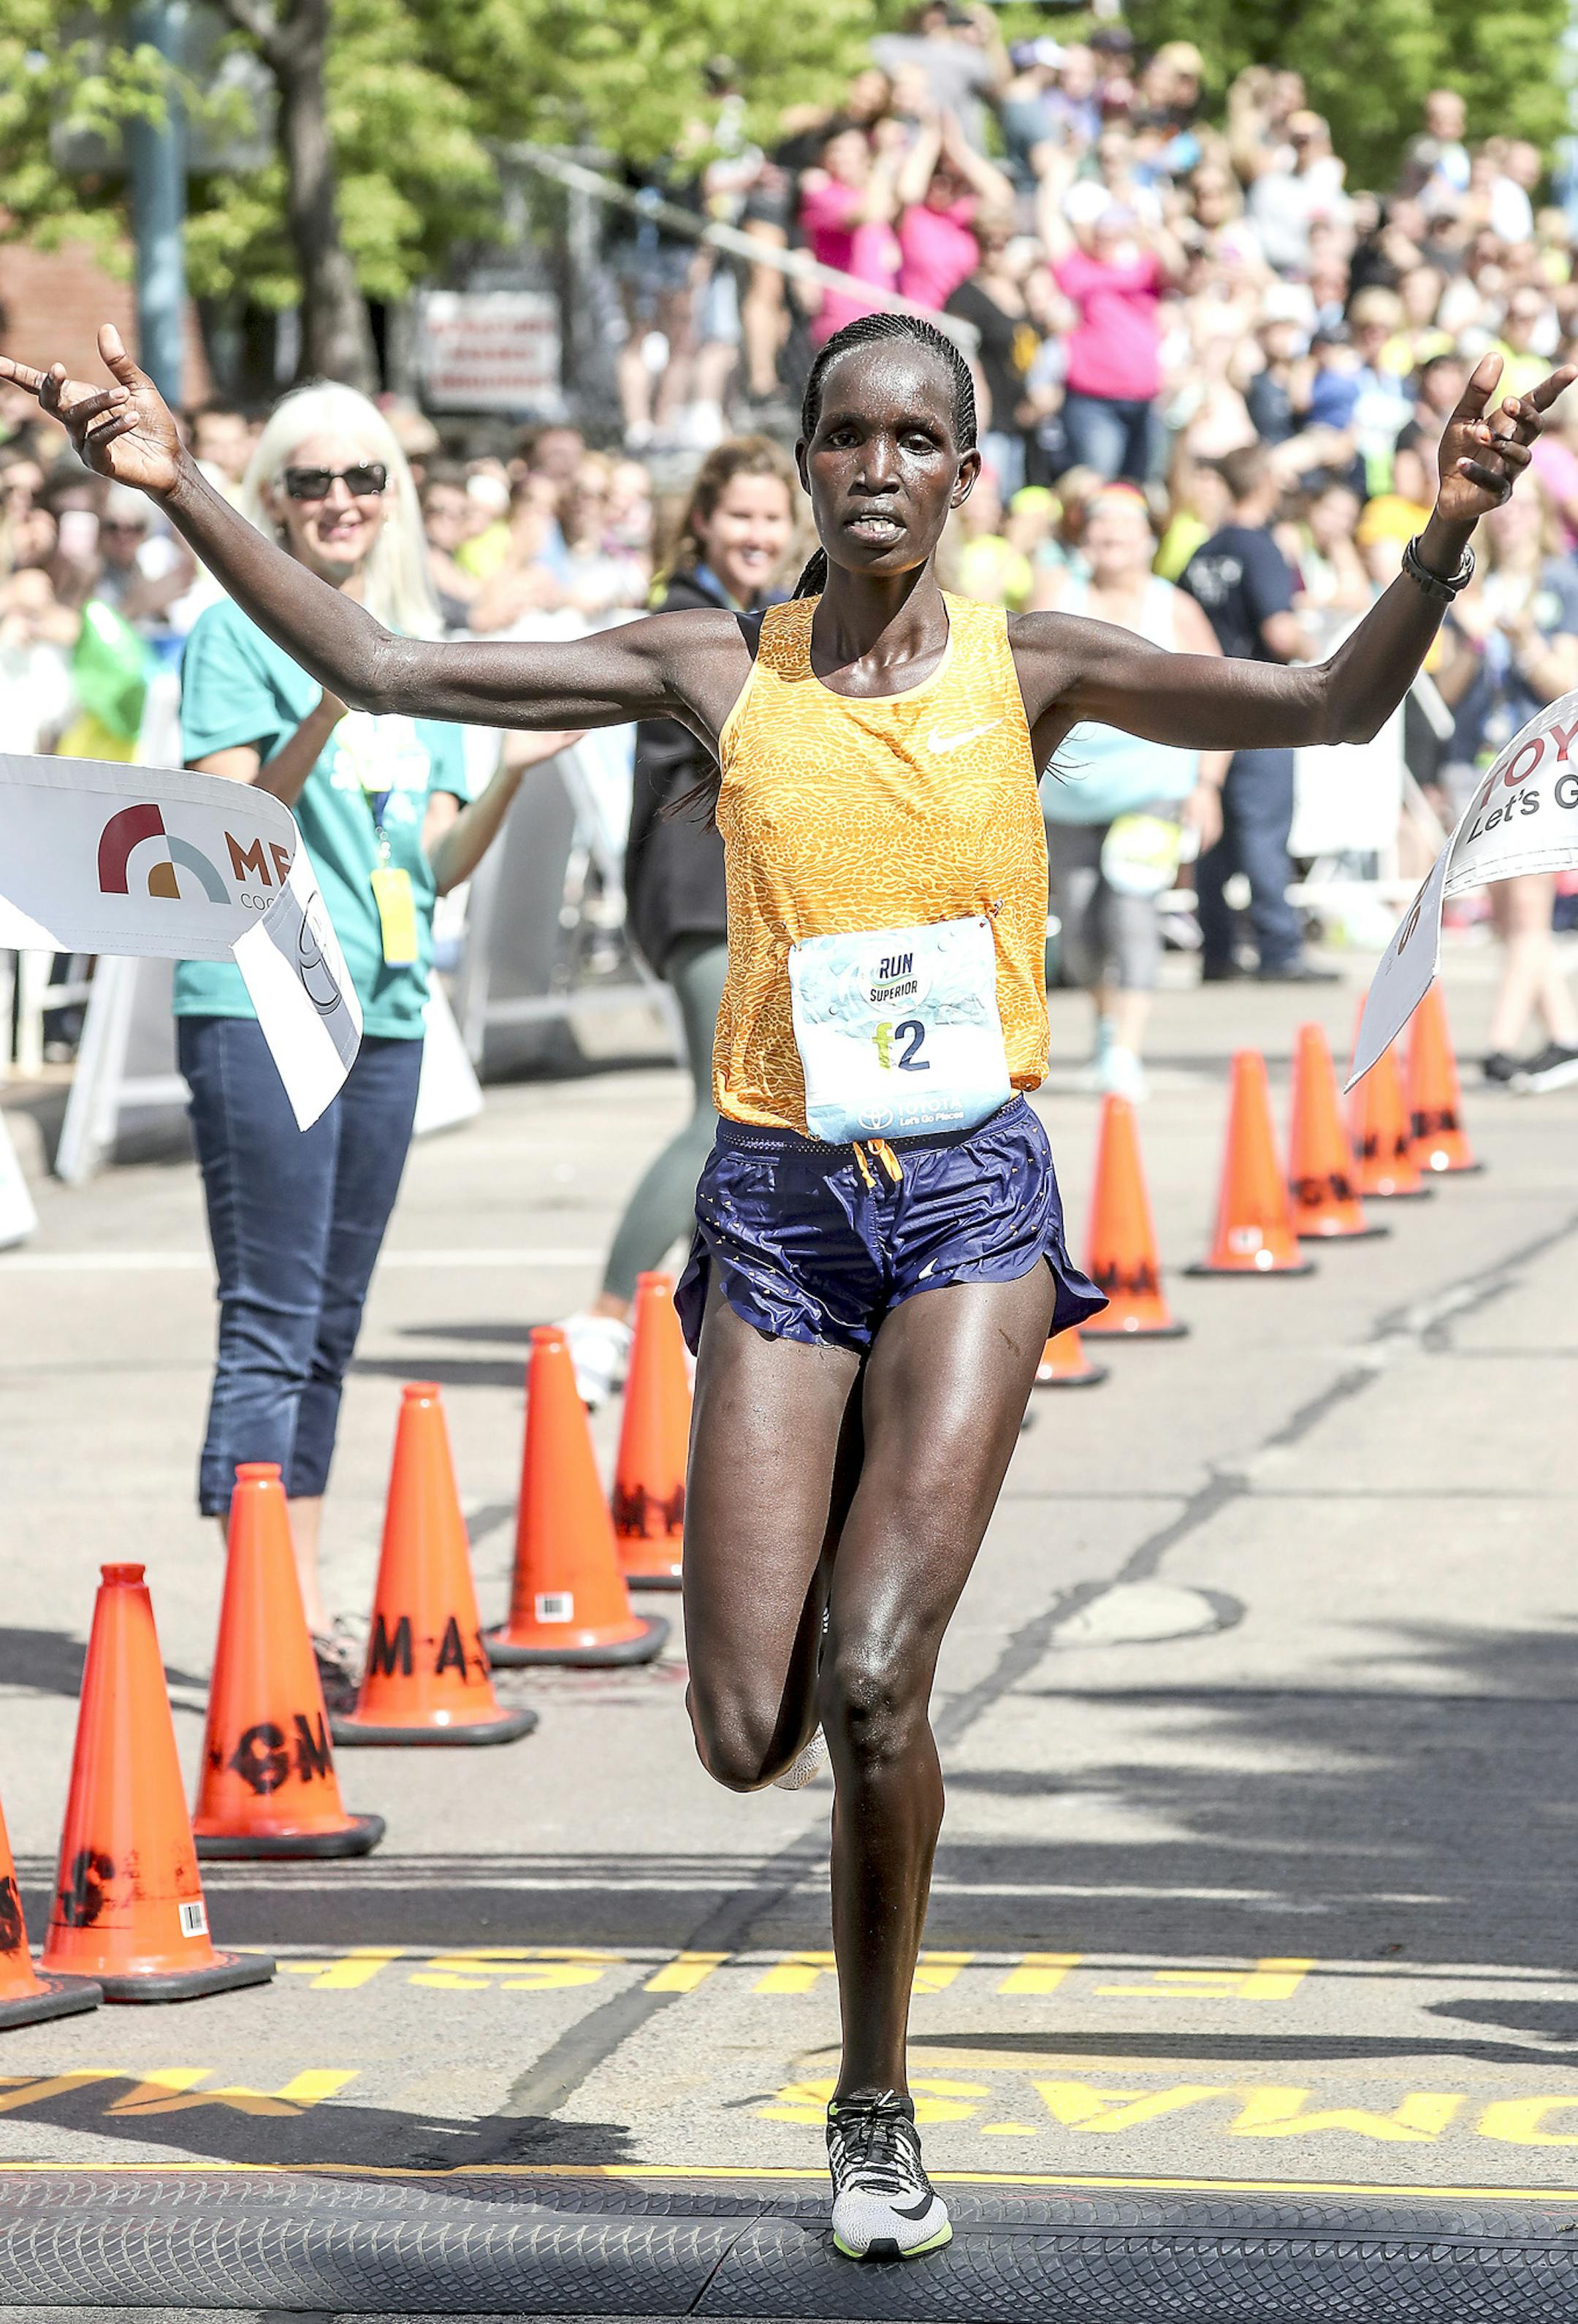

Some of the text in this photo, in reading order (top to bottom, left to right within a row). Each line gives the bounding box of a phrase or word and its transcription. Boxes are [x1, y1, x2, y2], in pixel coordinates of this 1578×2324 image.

[1466, 788, 1541, 845] Let's
[879, 952, 913, 979] RUN
[869, 980, 918, 1002] SUPERIOR
[872, 1020, 931, 1074] f2
[897, 1097, 963, 1116] TOYOTA
[899, 1110, 965, 1127] Let's Go Places
